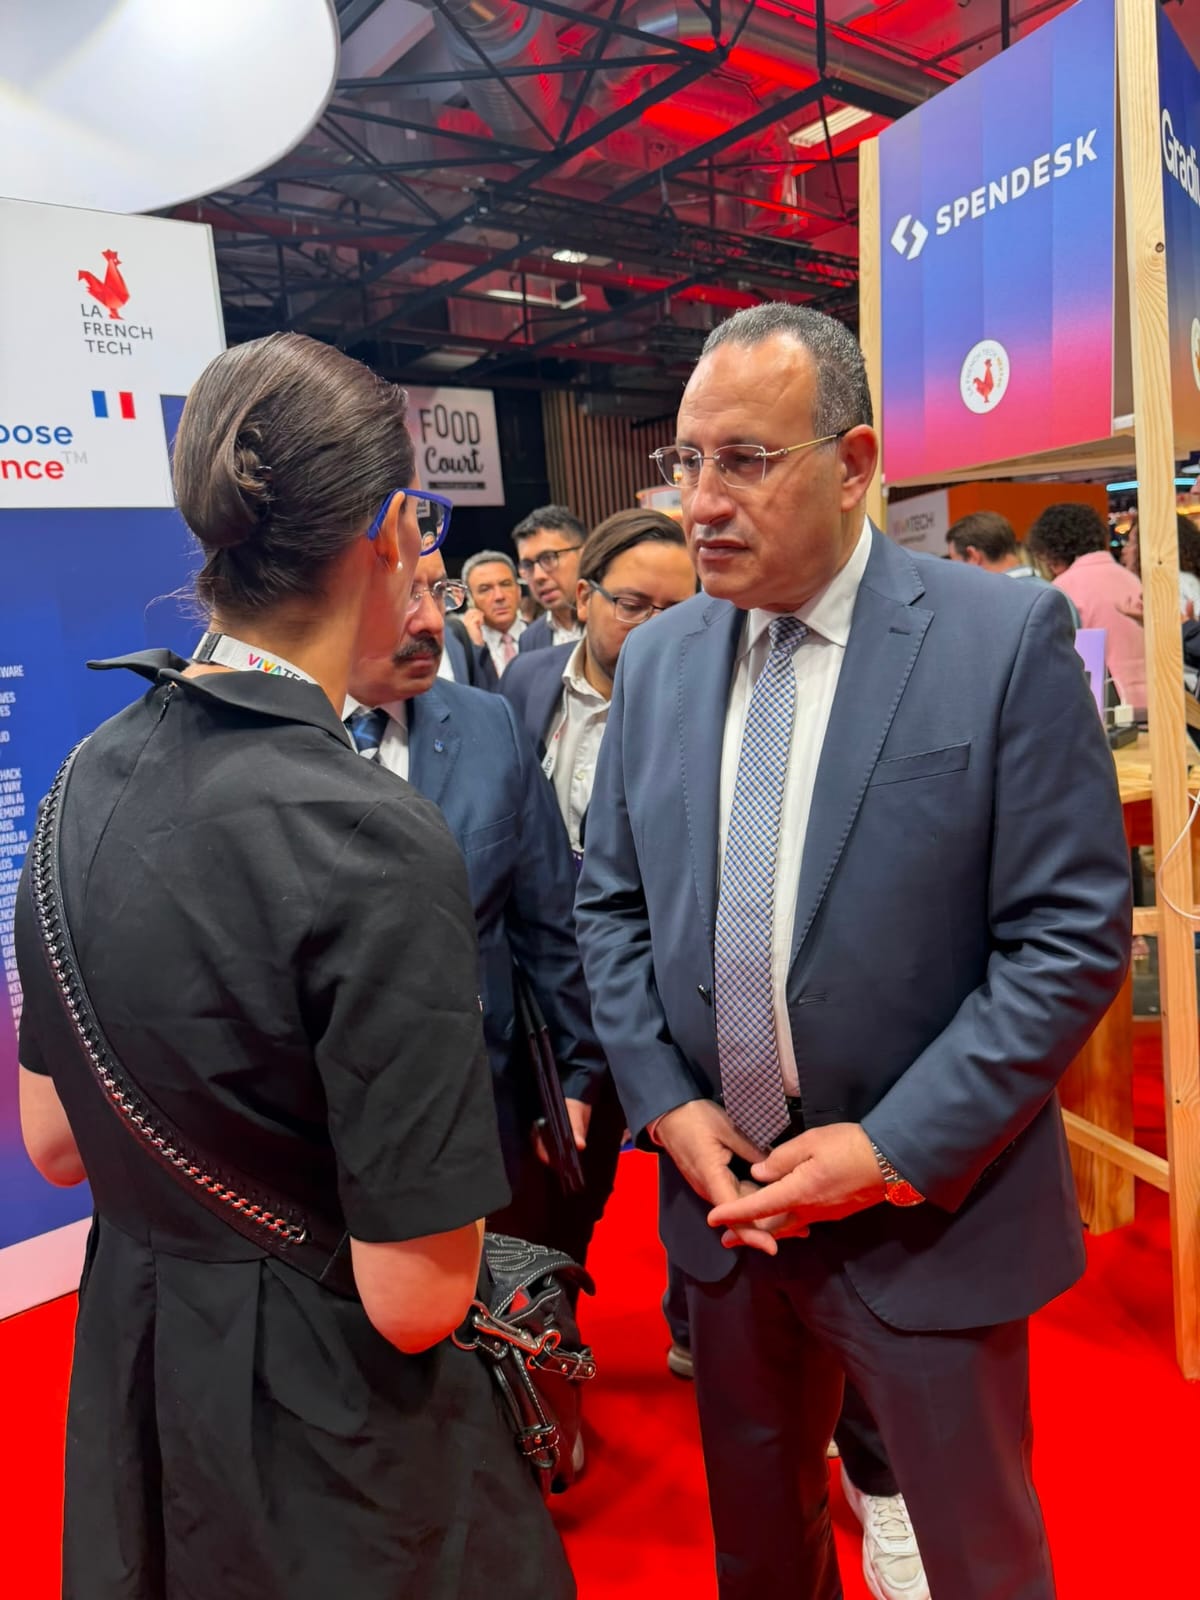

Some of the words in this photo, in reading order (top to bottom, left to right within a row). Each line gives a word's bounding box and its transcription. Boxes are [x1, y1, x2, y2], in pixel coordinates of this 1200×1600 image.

[936, 128, 1098, 236] SPENDESK
[81, 303, 103, 319] LA
[84, 321, 154, 340] FRENCH
[84, 339, 133, 356] TECH
[418, 404, 481, 446] FOOD
[1, 459, 65, 480] nce
[425, 446, 485, 475] Court
